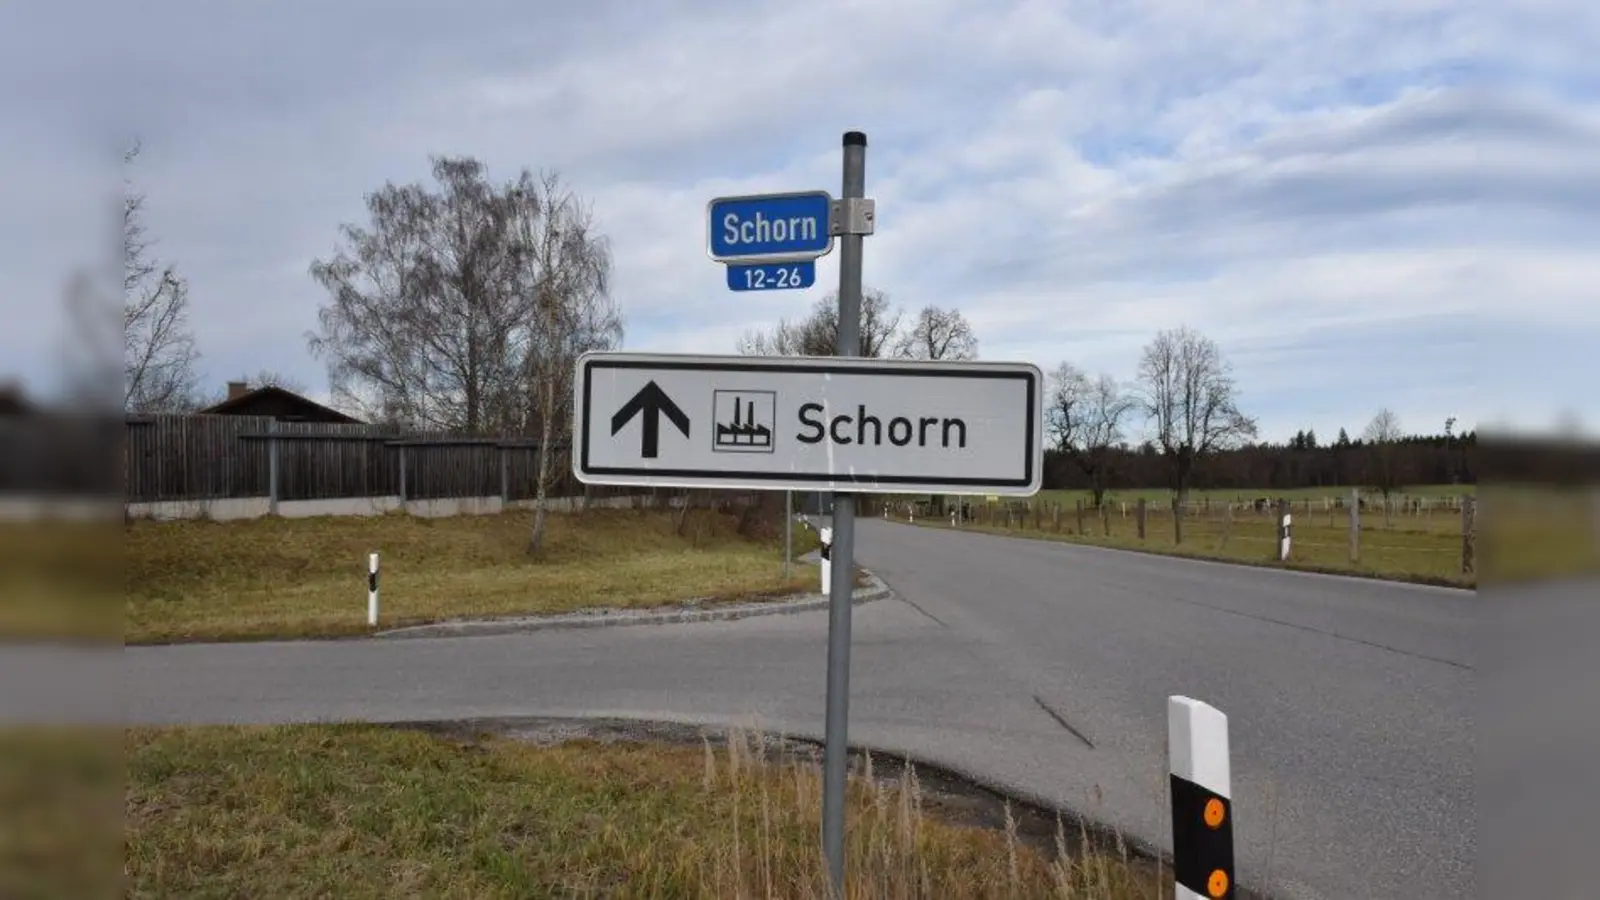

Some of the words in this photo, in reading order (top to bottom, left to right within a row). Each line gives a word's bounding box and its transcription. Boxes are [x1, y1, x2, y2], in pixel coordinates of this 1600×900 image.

[723, 211, 817, 245] Schorn
[744, 268, 802, 289] 12-26
[796, 402, 967, 449] Schorn
